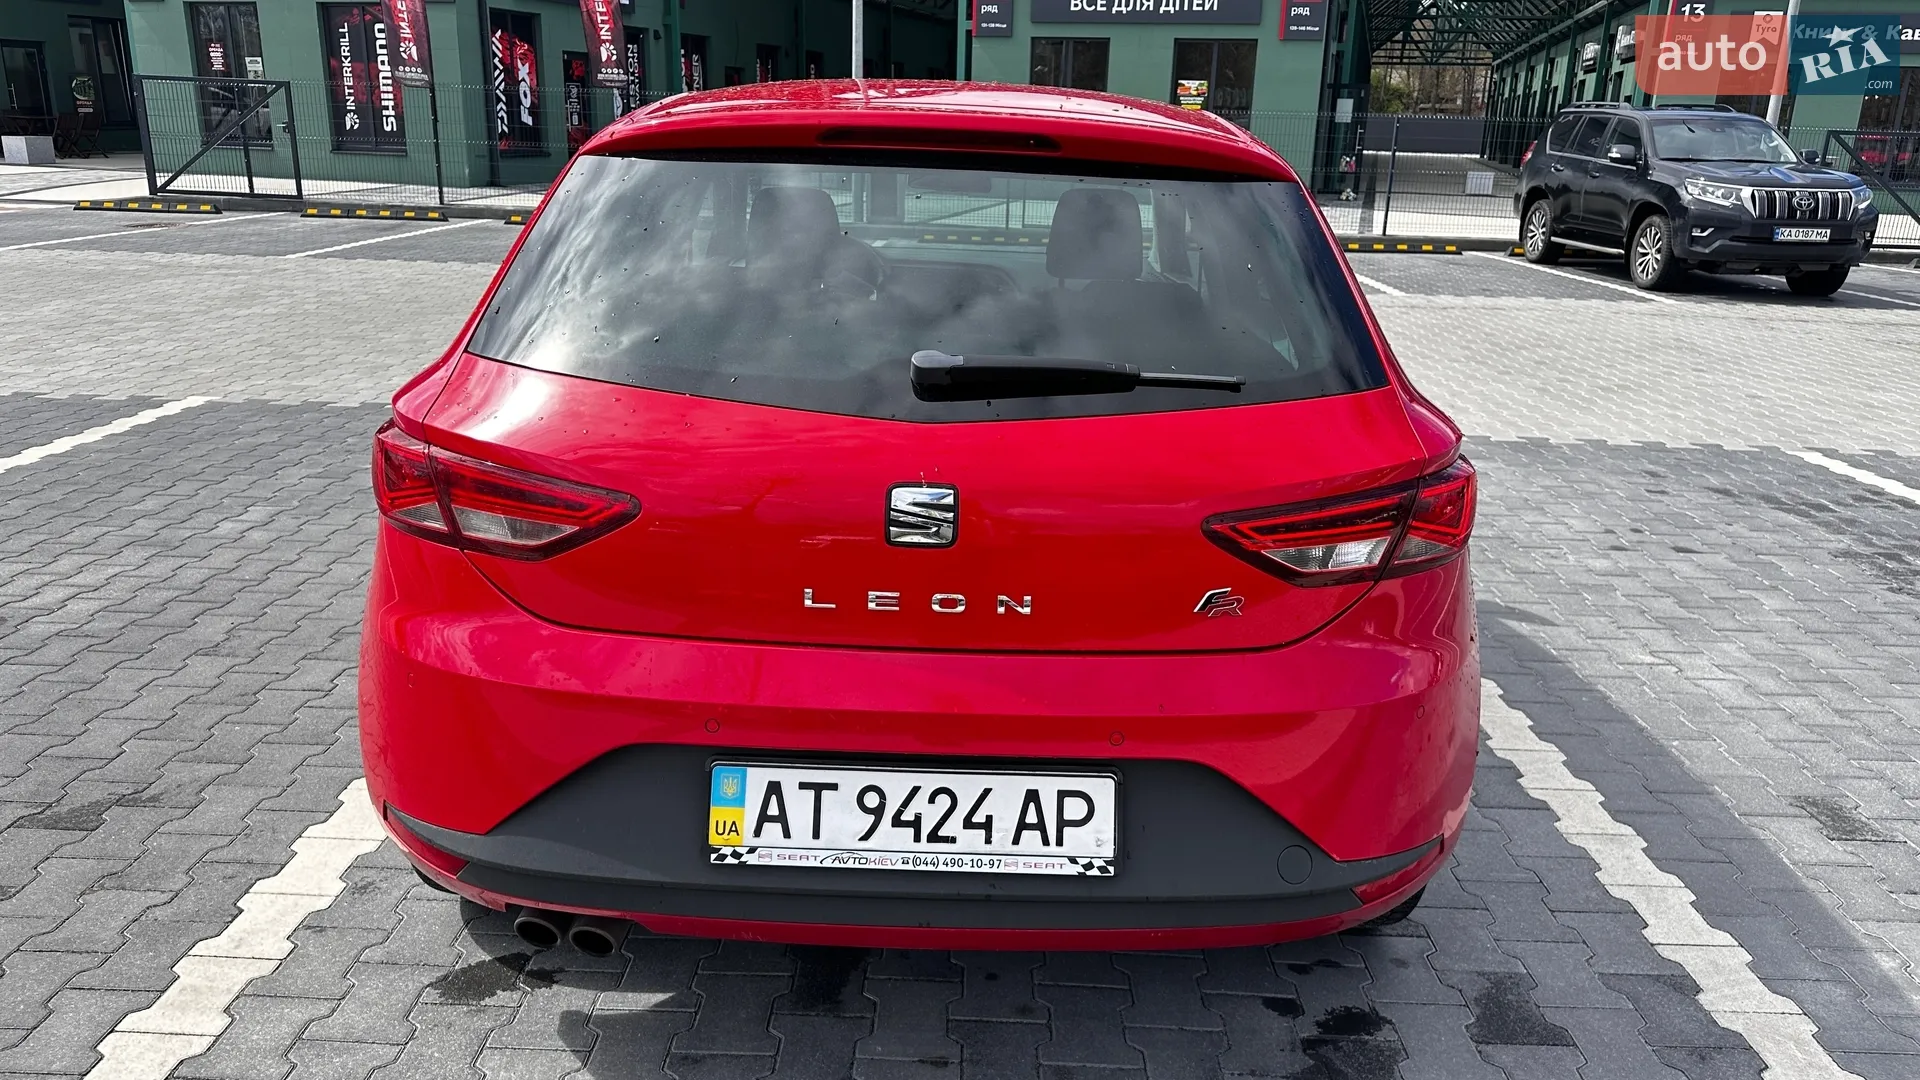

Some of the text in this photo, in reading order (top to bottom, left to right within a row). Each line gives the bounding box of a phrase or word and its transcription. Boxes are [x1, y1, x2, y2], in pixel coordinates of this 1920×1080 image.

[595, 0, 612, 39] INTE
[981, 5, 998, 14] ряд
[1291, 7, 1310, 16] ряд
[1681, 3, 1706, 22] 13
[339, 22, 356, 110] INTERKRILL
[517, 58, 533, 126] FOX
[1780, 229, 1828, 239] KA 0187 MA
[803, 588, 1031, 615] LEON
[1193, 587, 1245, 617] FR
[752, 780, 1095, 847] AT 9424 AP
[714, 819, 740, 837] UA
[777, 853, 821, 861] SEAT
[911, 855, 940, 869] (044)
[942, 858, 1002, 870] 490-10-97
[1022, 861, 1067, 869] SEAT
